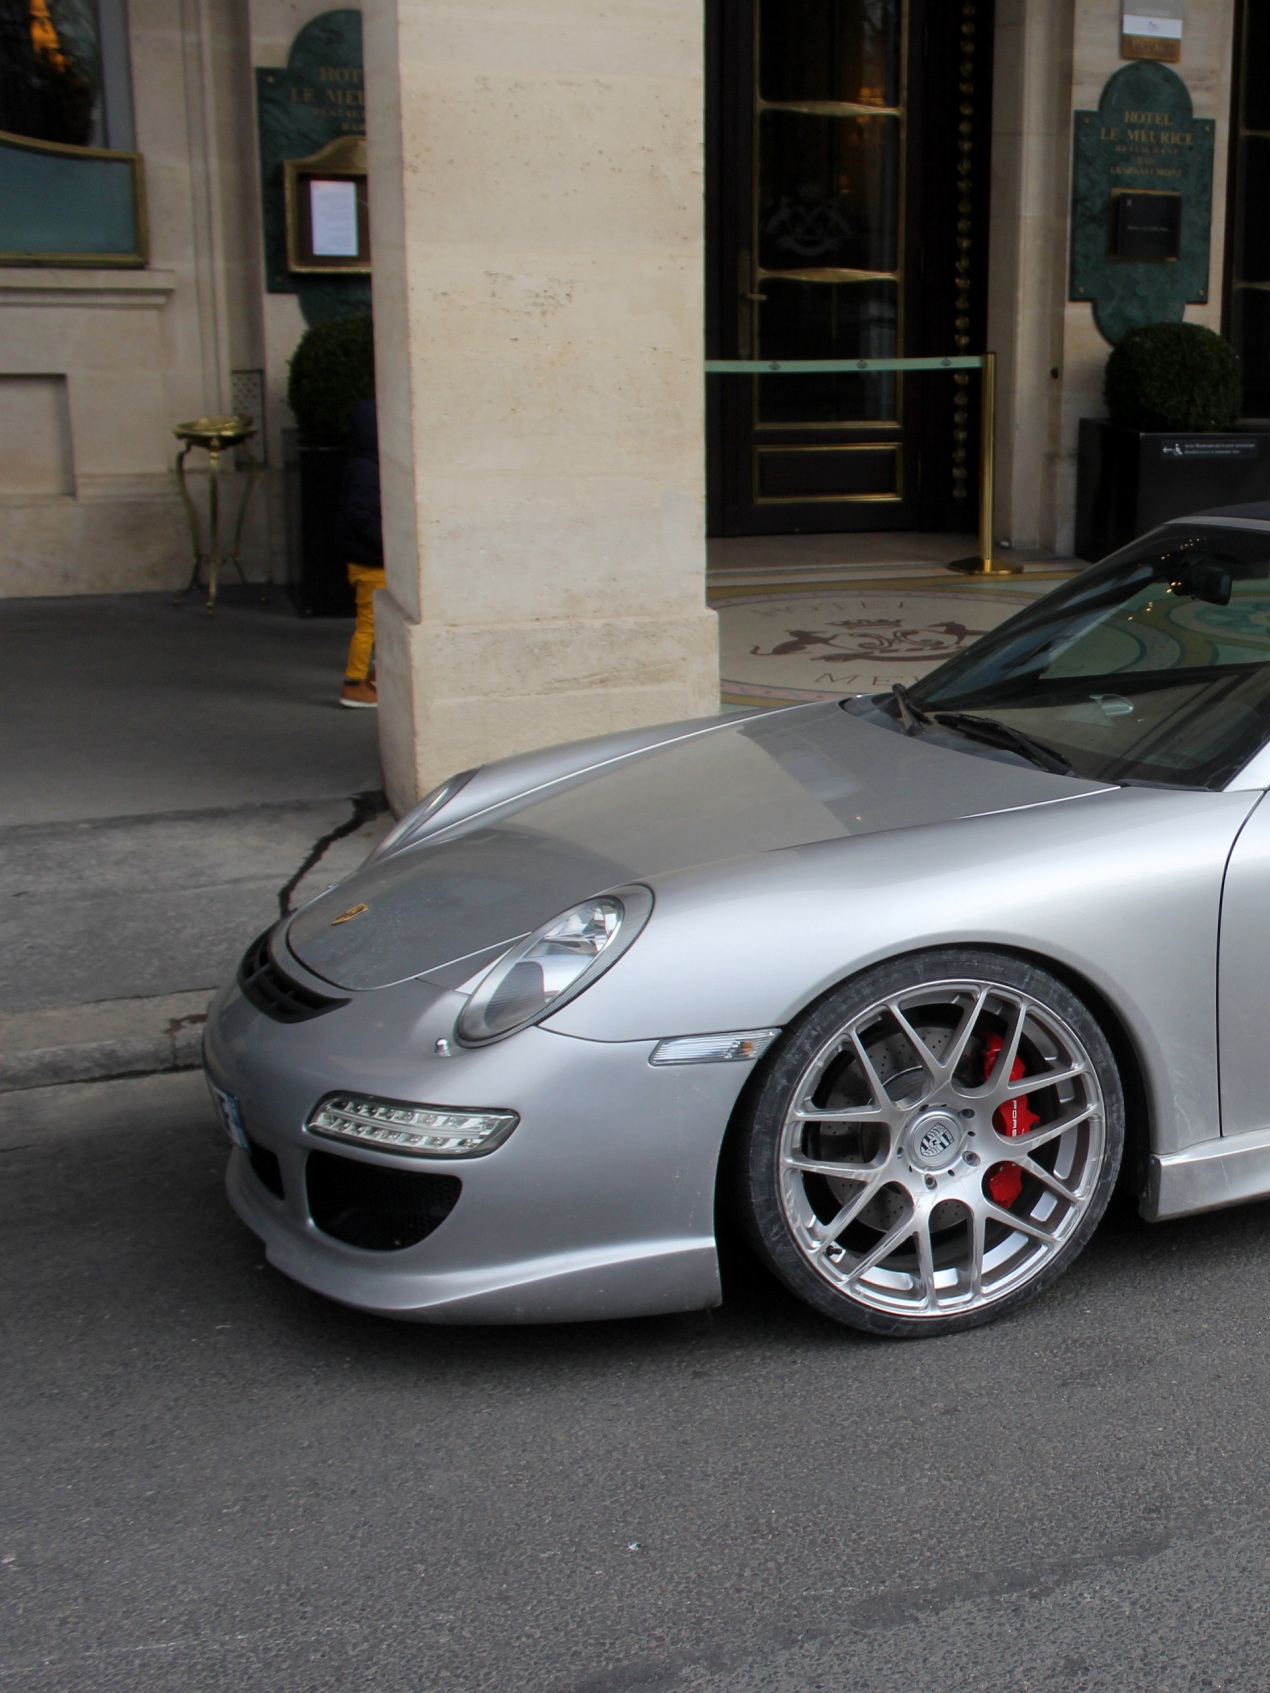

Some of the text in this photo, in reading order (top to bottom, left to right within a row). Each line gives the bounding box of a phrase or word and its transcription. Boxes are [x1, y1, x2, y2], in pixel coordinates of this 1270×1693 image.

[1124, 110, 1174, 125] HOTEL
[1100, 127, 1194, 144] LE MEURICE
